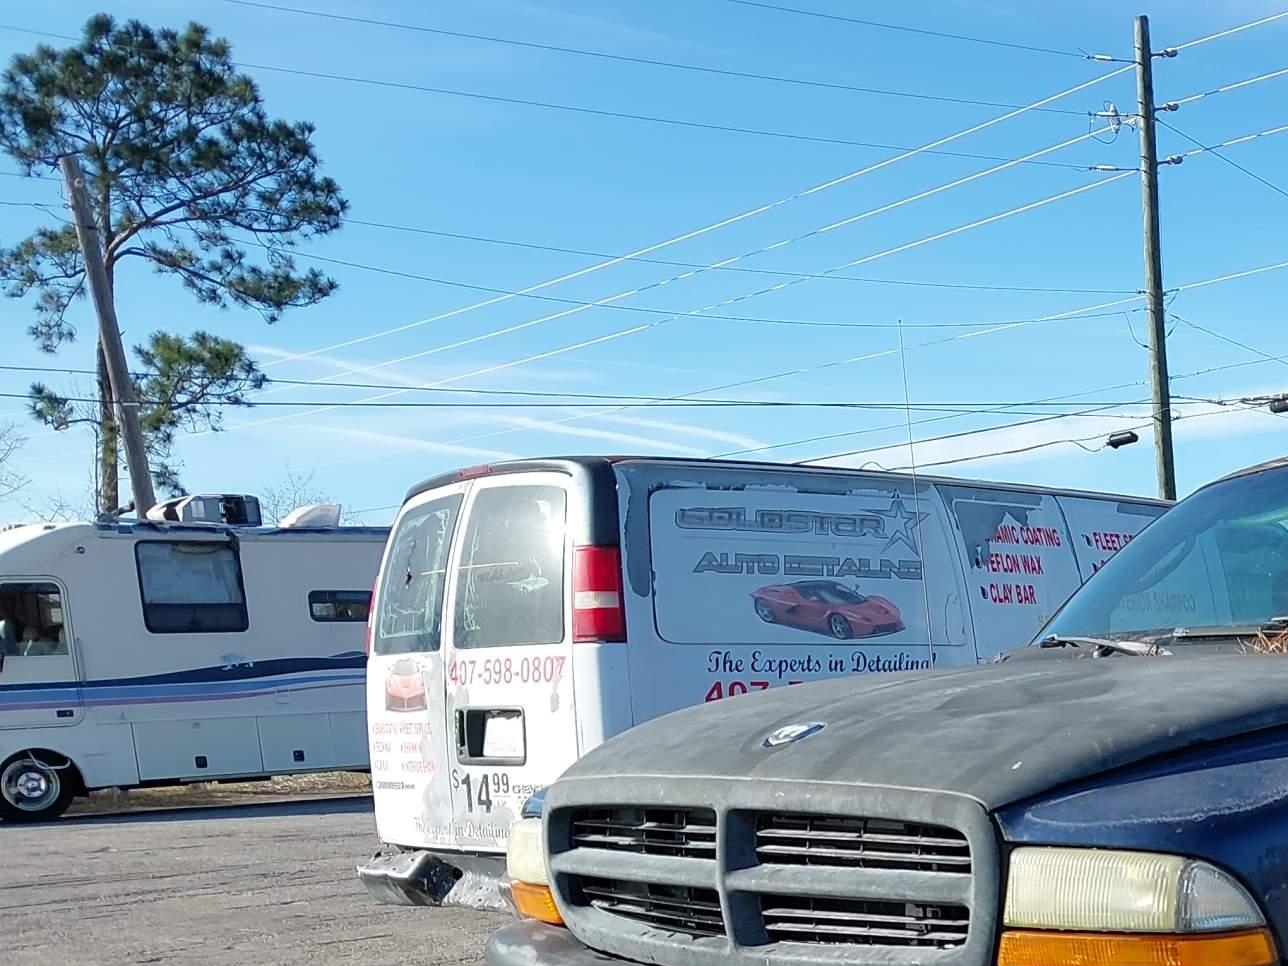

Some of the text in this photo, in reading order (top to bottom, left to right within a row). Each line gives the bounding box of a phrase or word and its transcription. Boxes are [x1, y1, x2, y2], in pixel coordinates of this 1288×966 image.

[1020, 526, 1060, 547] COATING
[693, 552, 779, 575] AUTO
[1021, 554, 1044, 575] WAX
[989, 583, 1036, 604] CLAY BAR
[450, 656, 566, 685] 407-598-0807
[707, 651, 744, 673] The
[751, 650, 821, 679] Experts
[828, 653, 845, 672] in
